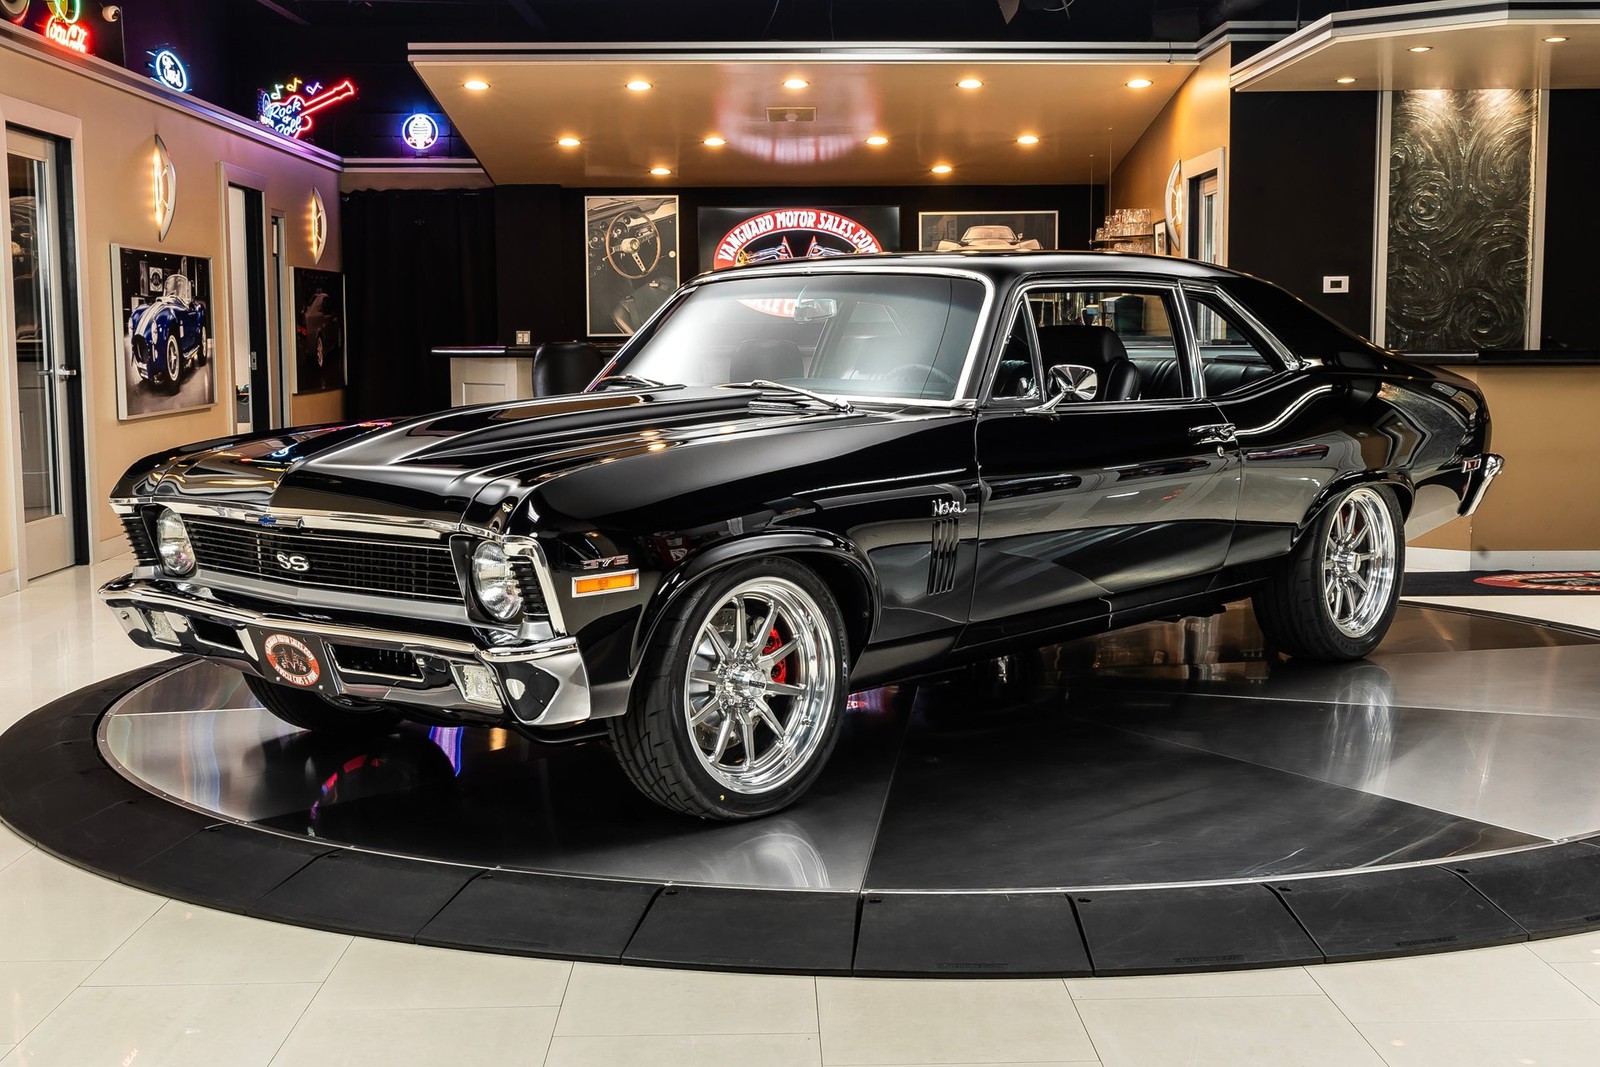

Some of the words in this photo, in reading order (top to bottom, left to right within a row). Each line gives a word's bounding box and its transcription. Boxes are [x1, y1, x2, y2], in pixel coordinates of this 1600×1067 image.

[265, 97, 302, 119] Rock
[717, 215, 775, 262] VANGUARD
[775, 210, 817, 229] MOTOR
[817, 212, 879, 256] SALES.COM
[931, 498, 968, 517] Nova
[277, 549, 309, 571] SS
